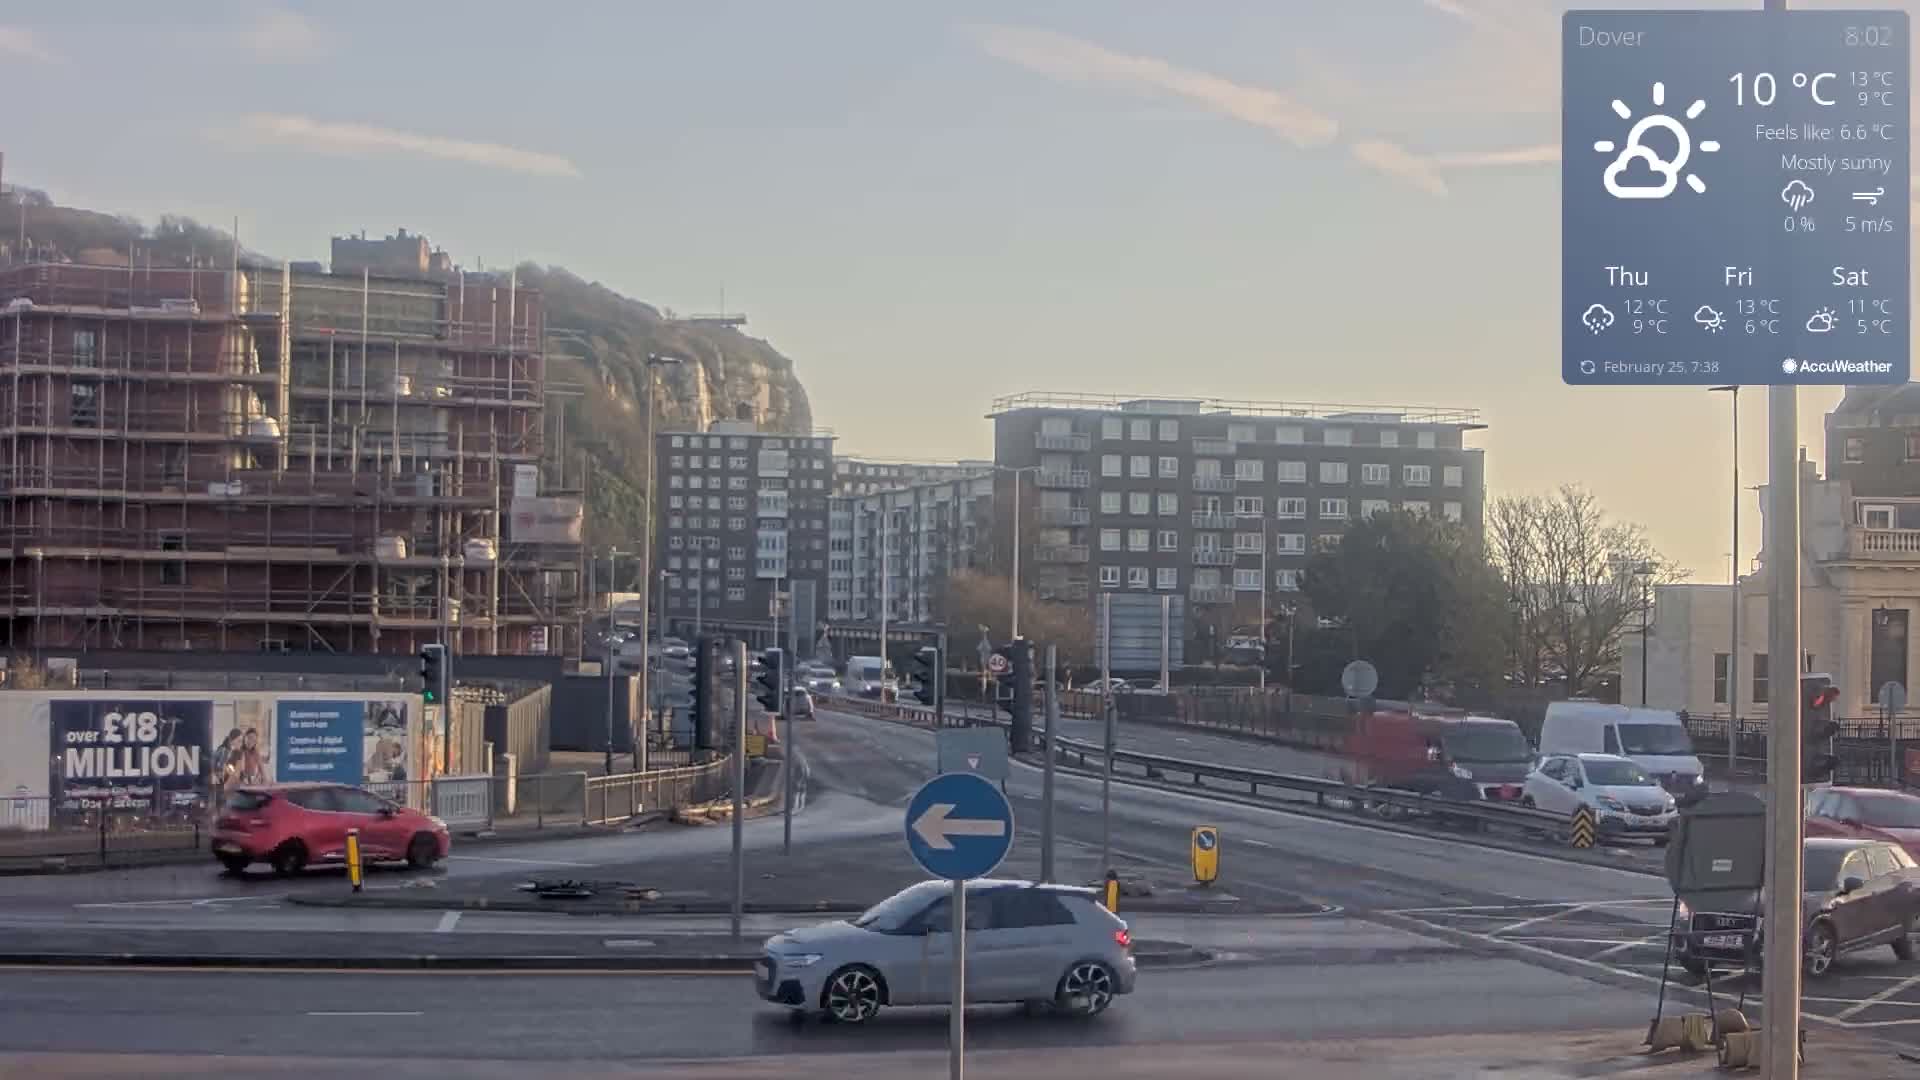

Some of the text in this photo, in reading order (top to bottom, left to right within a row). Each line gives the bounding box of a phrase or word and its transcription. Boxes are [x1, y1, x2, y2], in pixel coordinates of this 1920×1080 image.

[66, 712, 159, 743] over £18
[66, 745, 201, 778] MILLION
